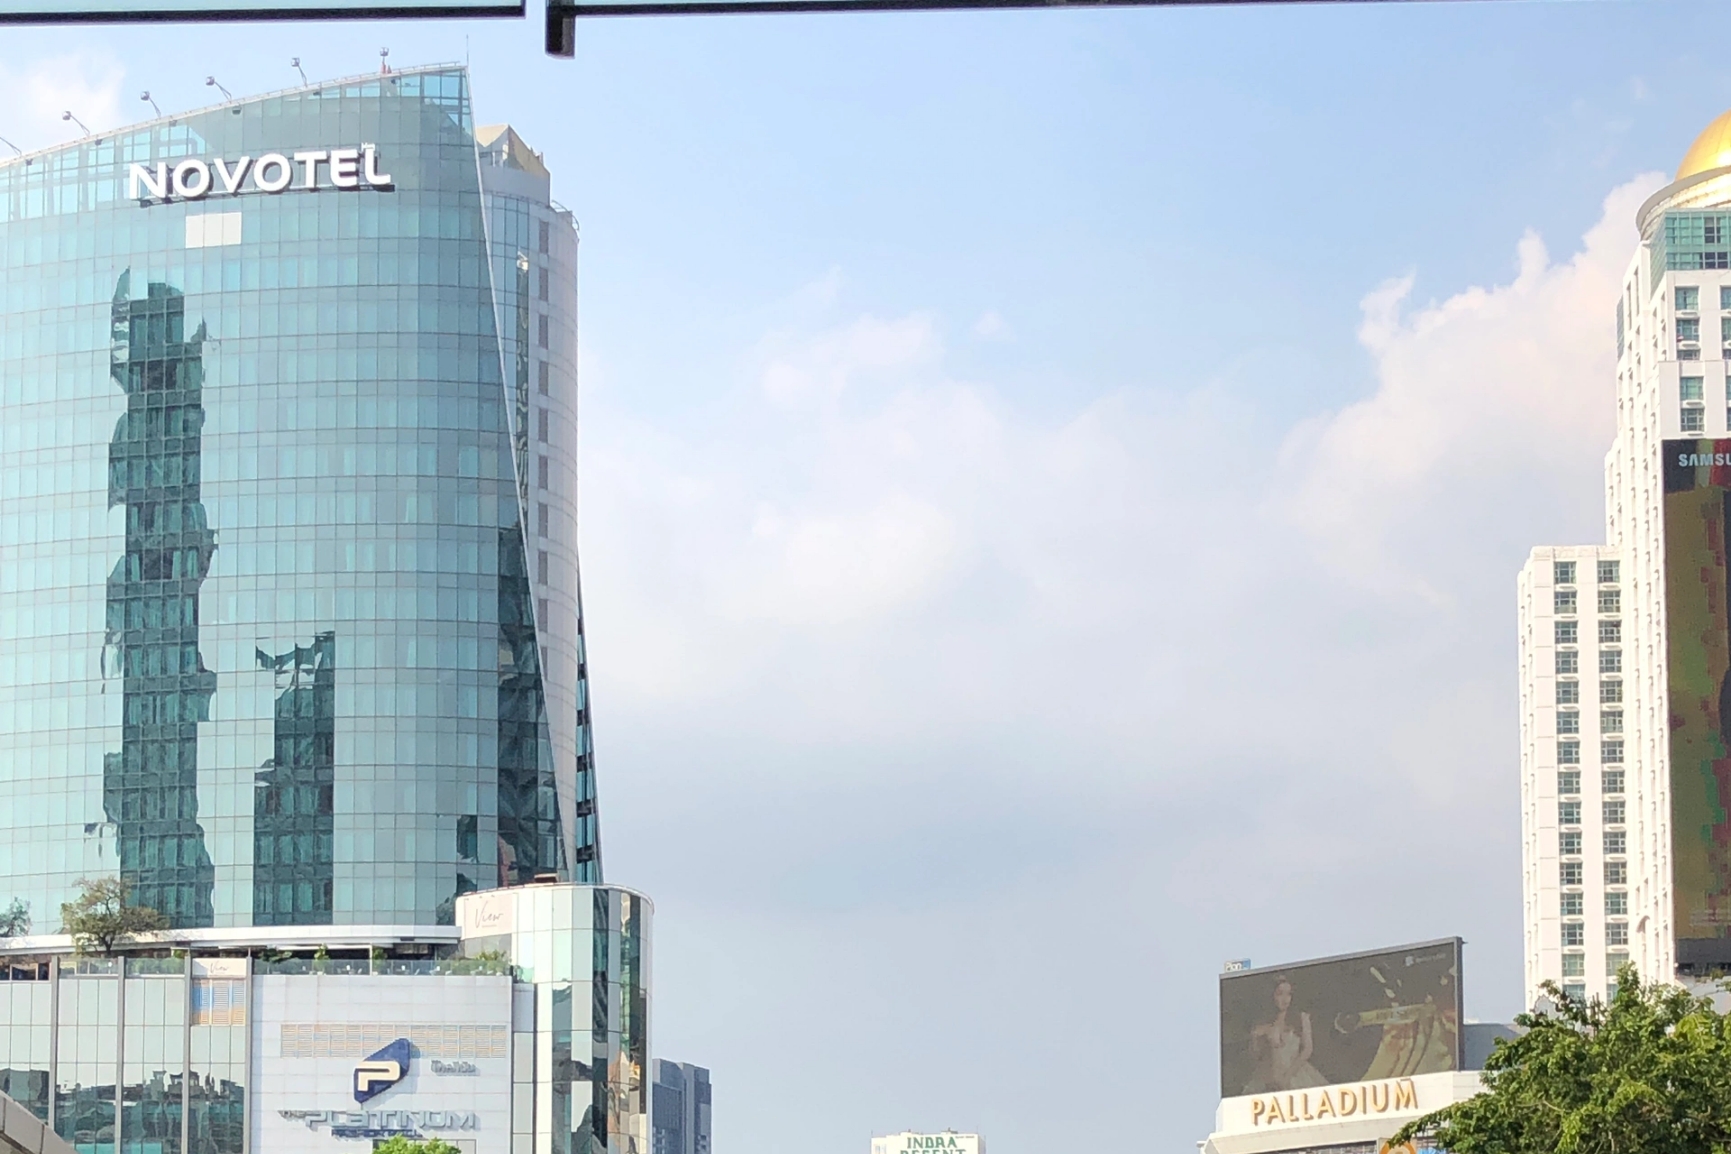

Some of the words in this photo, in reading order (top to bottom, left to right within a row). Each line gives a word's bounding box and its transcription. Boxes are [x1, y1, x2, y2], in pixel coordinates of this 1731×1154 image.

[129, 147, 391, 199] NOVOTEL
[1250, 1079, 1419, 1126] PALLADIUM
[906, 1136, 957, 1149] INDRA
